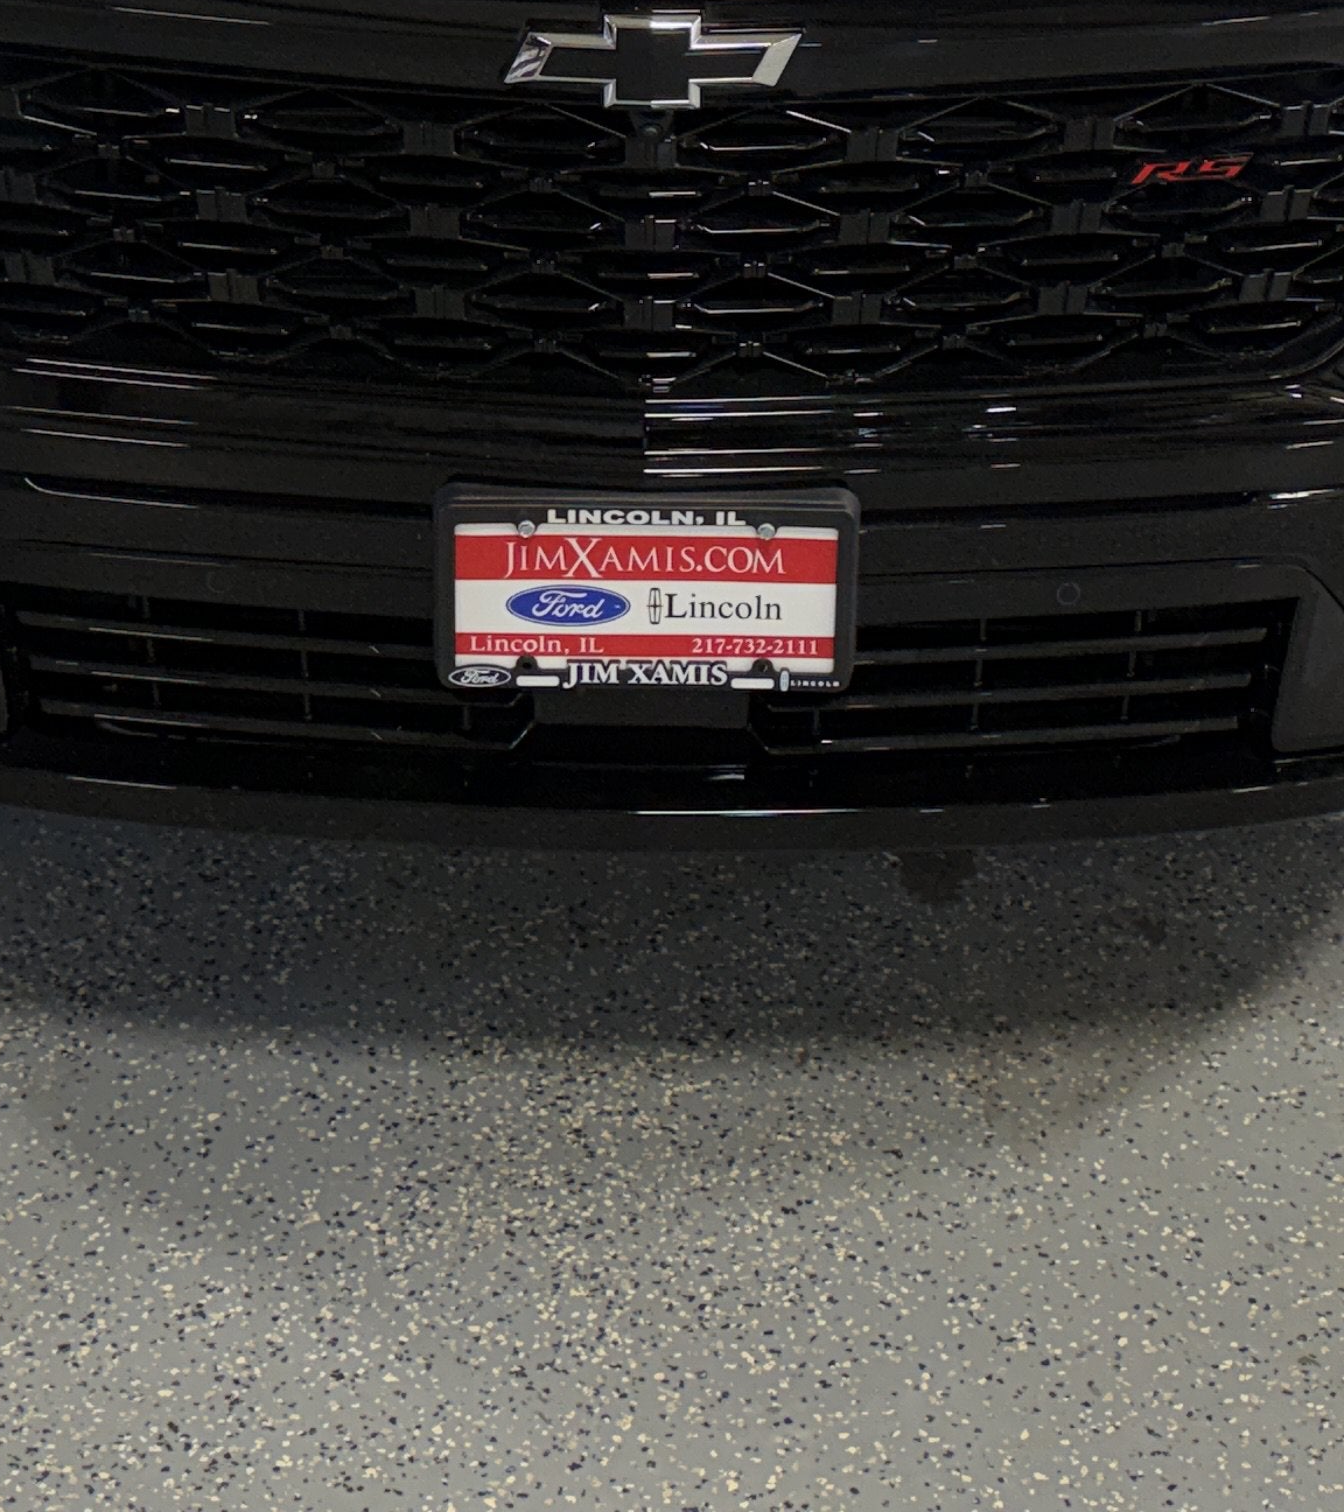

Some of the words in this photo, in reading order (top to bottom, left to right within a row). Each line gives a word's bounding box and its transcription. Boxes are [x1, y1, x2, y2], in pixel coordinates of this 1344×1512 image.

[1131, 151, 1255, 185] RS
[546, 508, 705, 527] LINCOLN,
[716, 510, 747, 526] IL
[503, 537, 787, 579] JIMXAMIS.COM
[531, 592, 604, 620] Ford
[664, 593, 783, 621] Lincoln
[469, 635, 571, 655] Lincoln,
[579, 637, 605, 654] IL
[691, 637, 819, 656] 217-732-2111
[562, 660, 621, 690] JIM
[626, 660, 728, 687] XAMIS
